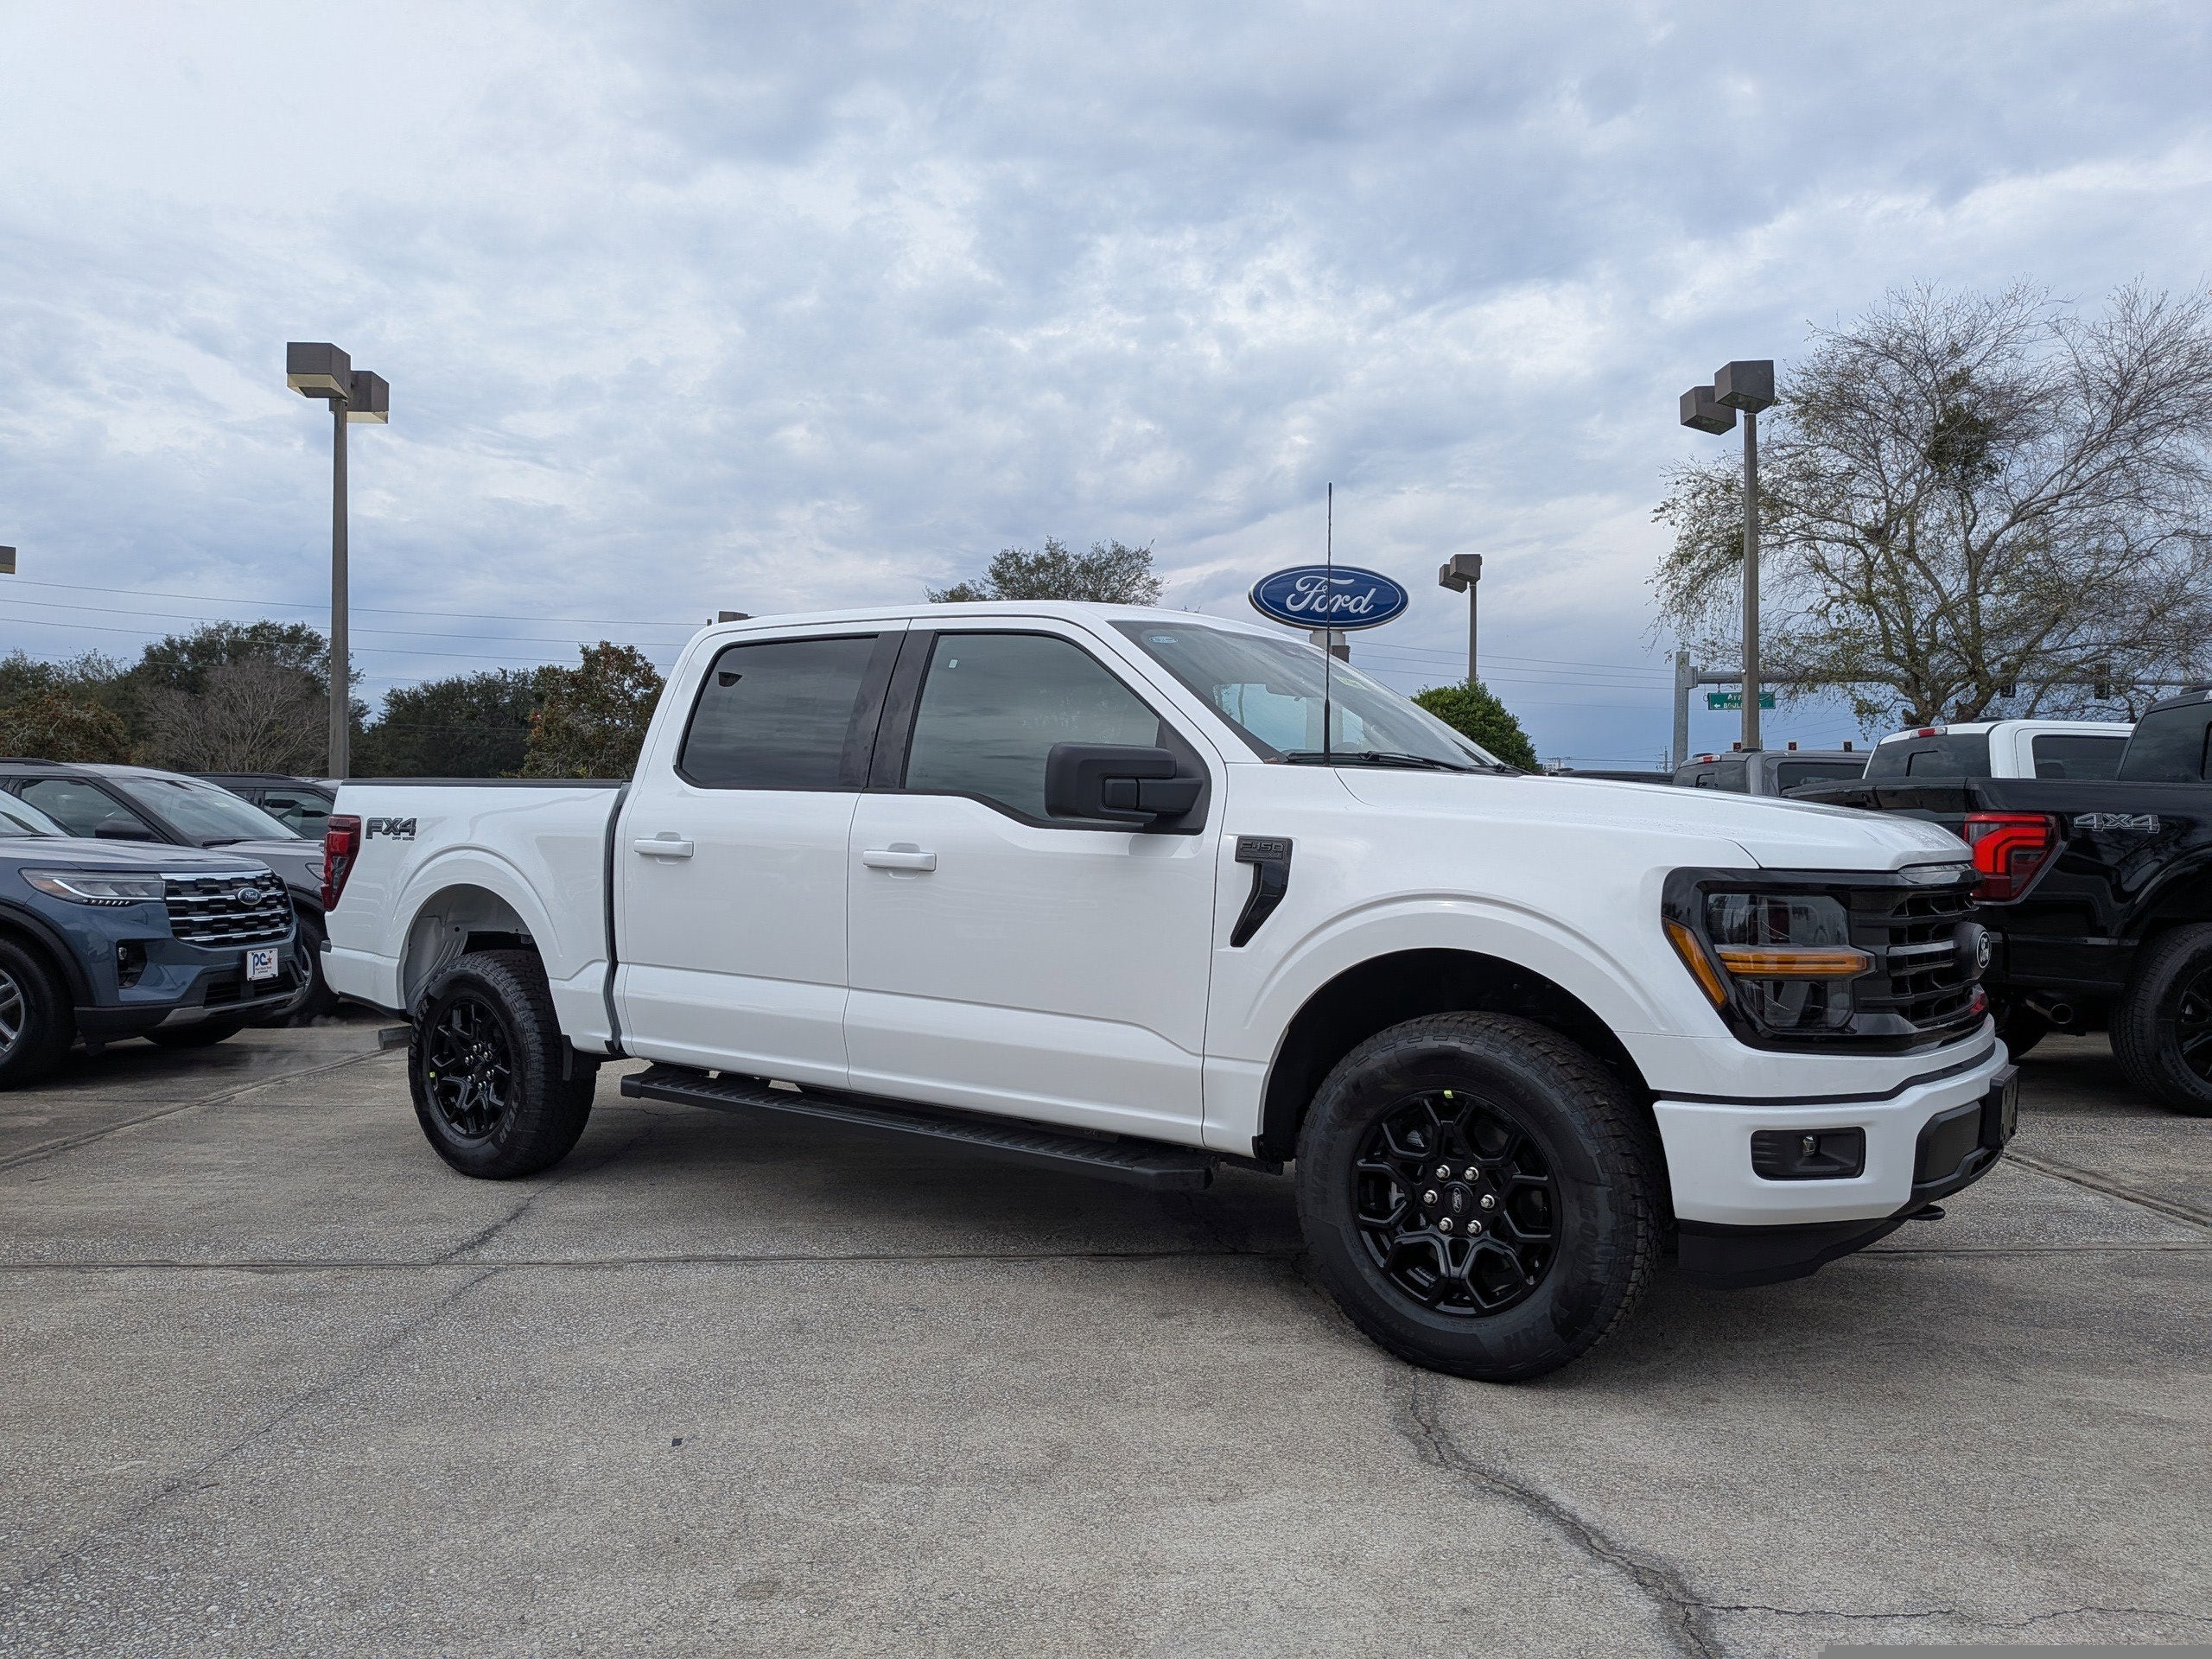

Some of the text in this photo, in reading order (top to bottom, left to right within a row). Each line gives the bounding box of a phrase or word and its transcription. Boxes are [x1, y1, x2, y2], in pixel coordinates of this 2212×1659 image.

[1286, 575, 1376, 613] Ford
[365, 817, 417, 839] FX4
[1240, 842, 1285, 852] F-150
